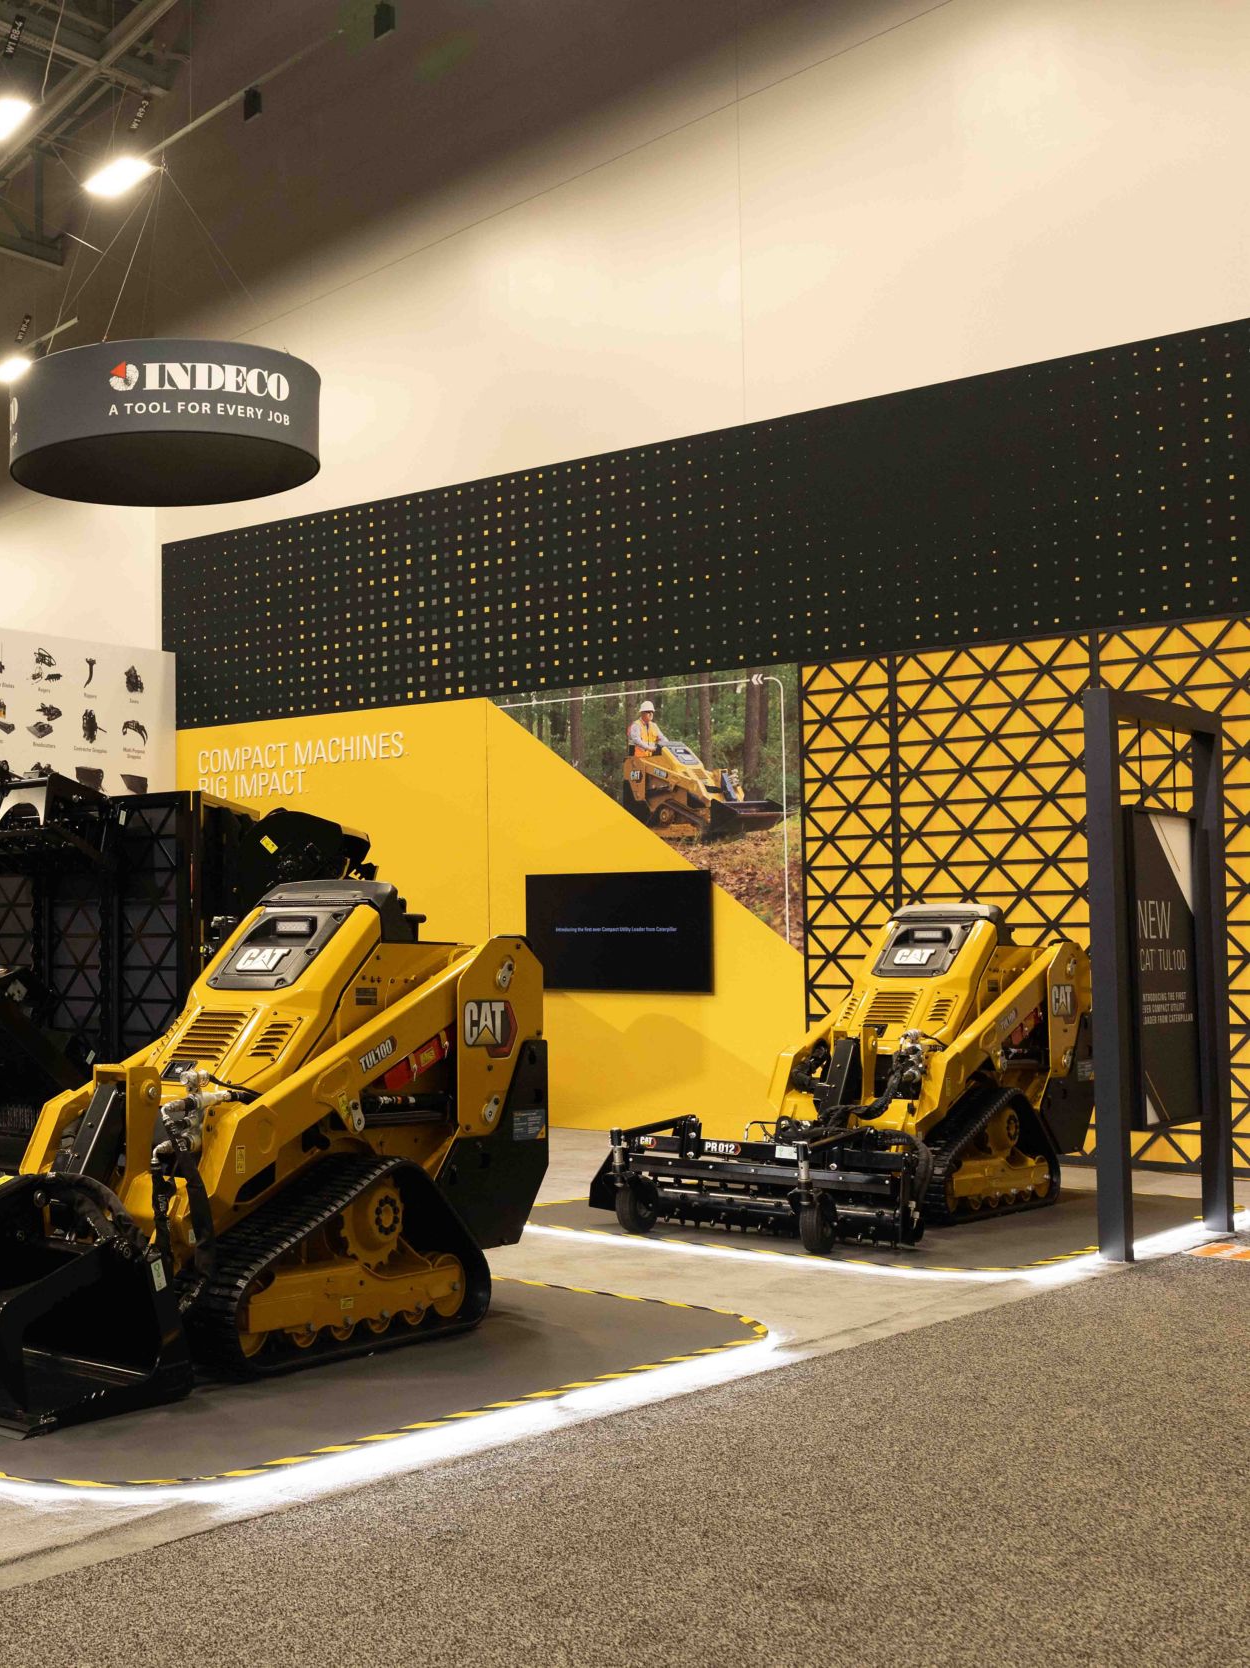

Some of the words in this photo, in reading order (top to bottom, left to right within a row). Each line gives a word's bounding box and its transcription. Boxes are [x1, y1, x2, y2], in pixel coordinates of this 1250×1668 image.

[10, 20, 23, 40] R8-4
[6, 42, 16, 53] W1
[130, 118, 140, 128] W1
[136, 100, 149, 118] R9-3
[142, 362, 290, 402] INDECO
[108, 404, 118, 416] A
[124, 402, 170, 414] TOOL
[177, 402, 211, 414] FOR
[216, 403, 264, 420] EVERY
[268, 410, 290, 426] JOB
[198, 743, 288, 774] COMPACT
[294, 731, 410, 766] MACHINES.
[198, 776, 228, 800] BIG
[234, 768, 310, 798] IMPACT.
[1138, 900, 1170, 939] NEW
[236, 948, 290, 970] CAT
[894, 948, 936, 965] CAT
[1158, 948, 1186, 971] TUL100
[1052, 986, 1072, 1016] CAT
[1142, 992, 1167, 1002] NTRODUCING
[1176, 991, 1186, 1000] FIRST
[1152, 1004, 1170, 1013] COMPACT
[1170, 1003, 1184, 1012] UTILITY
[464, 1001, 505, 1046] CAT
[1157, 1015, 1168, 1024] FROM
[1169, 1013, 1193, 1023] CATERPILLAR
[359, 1038, 394, 1073] TUL100
[640, 1136, 653, 1146] CAT
